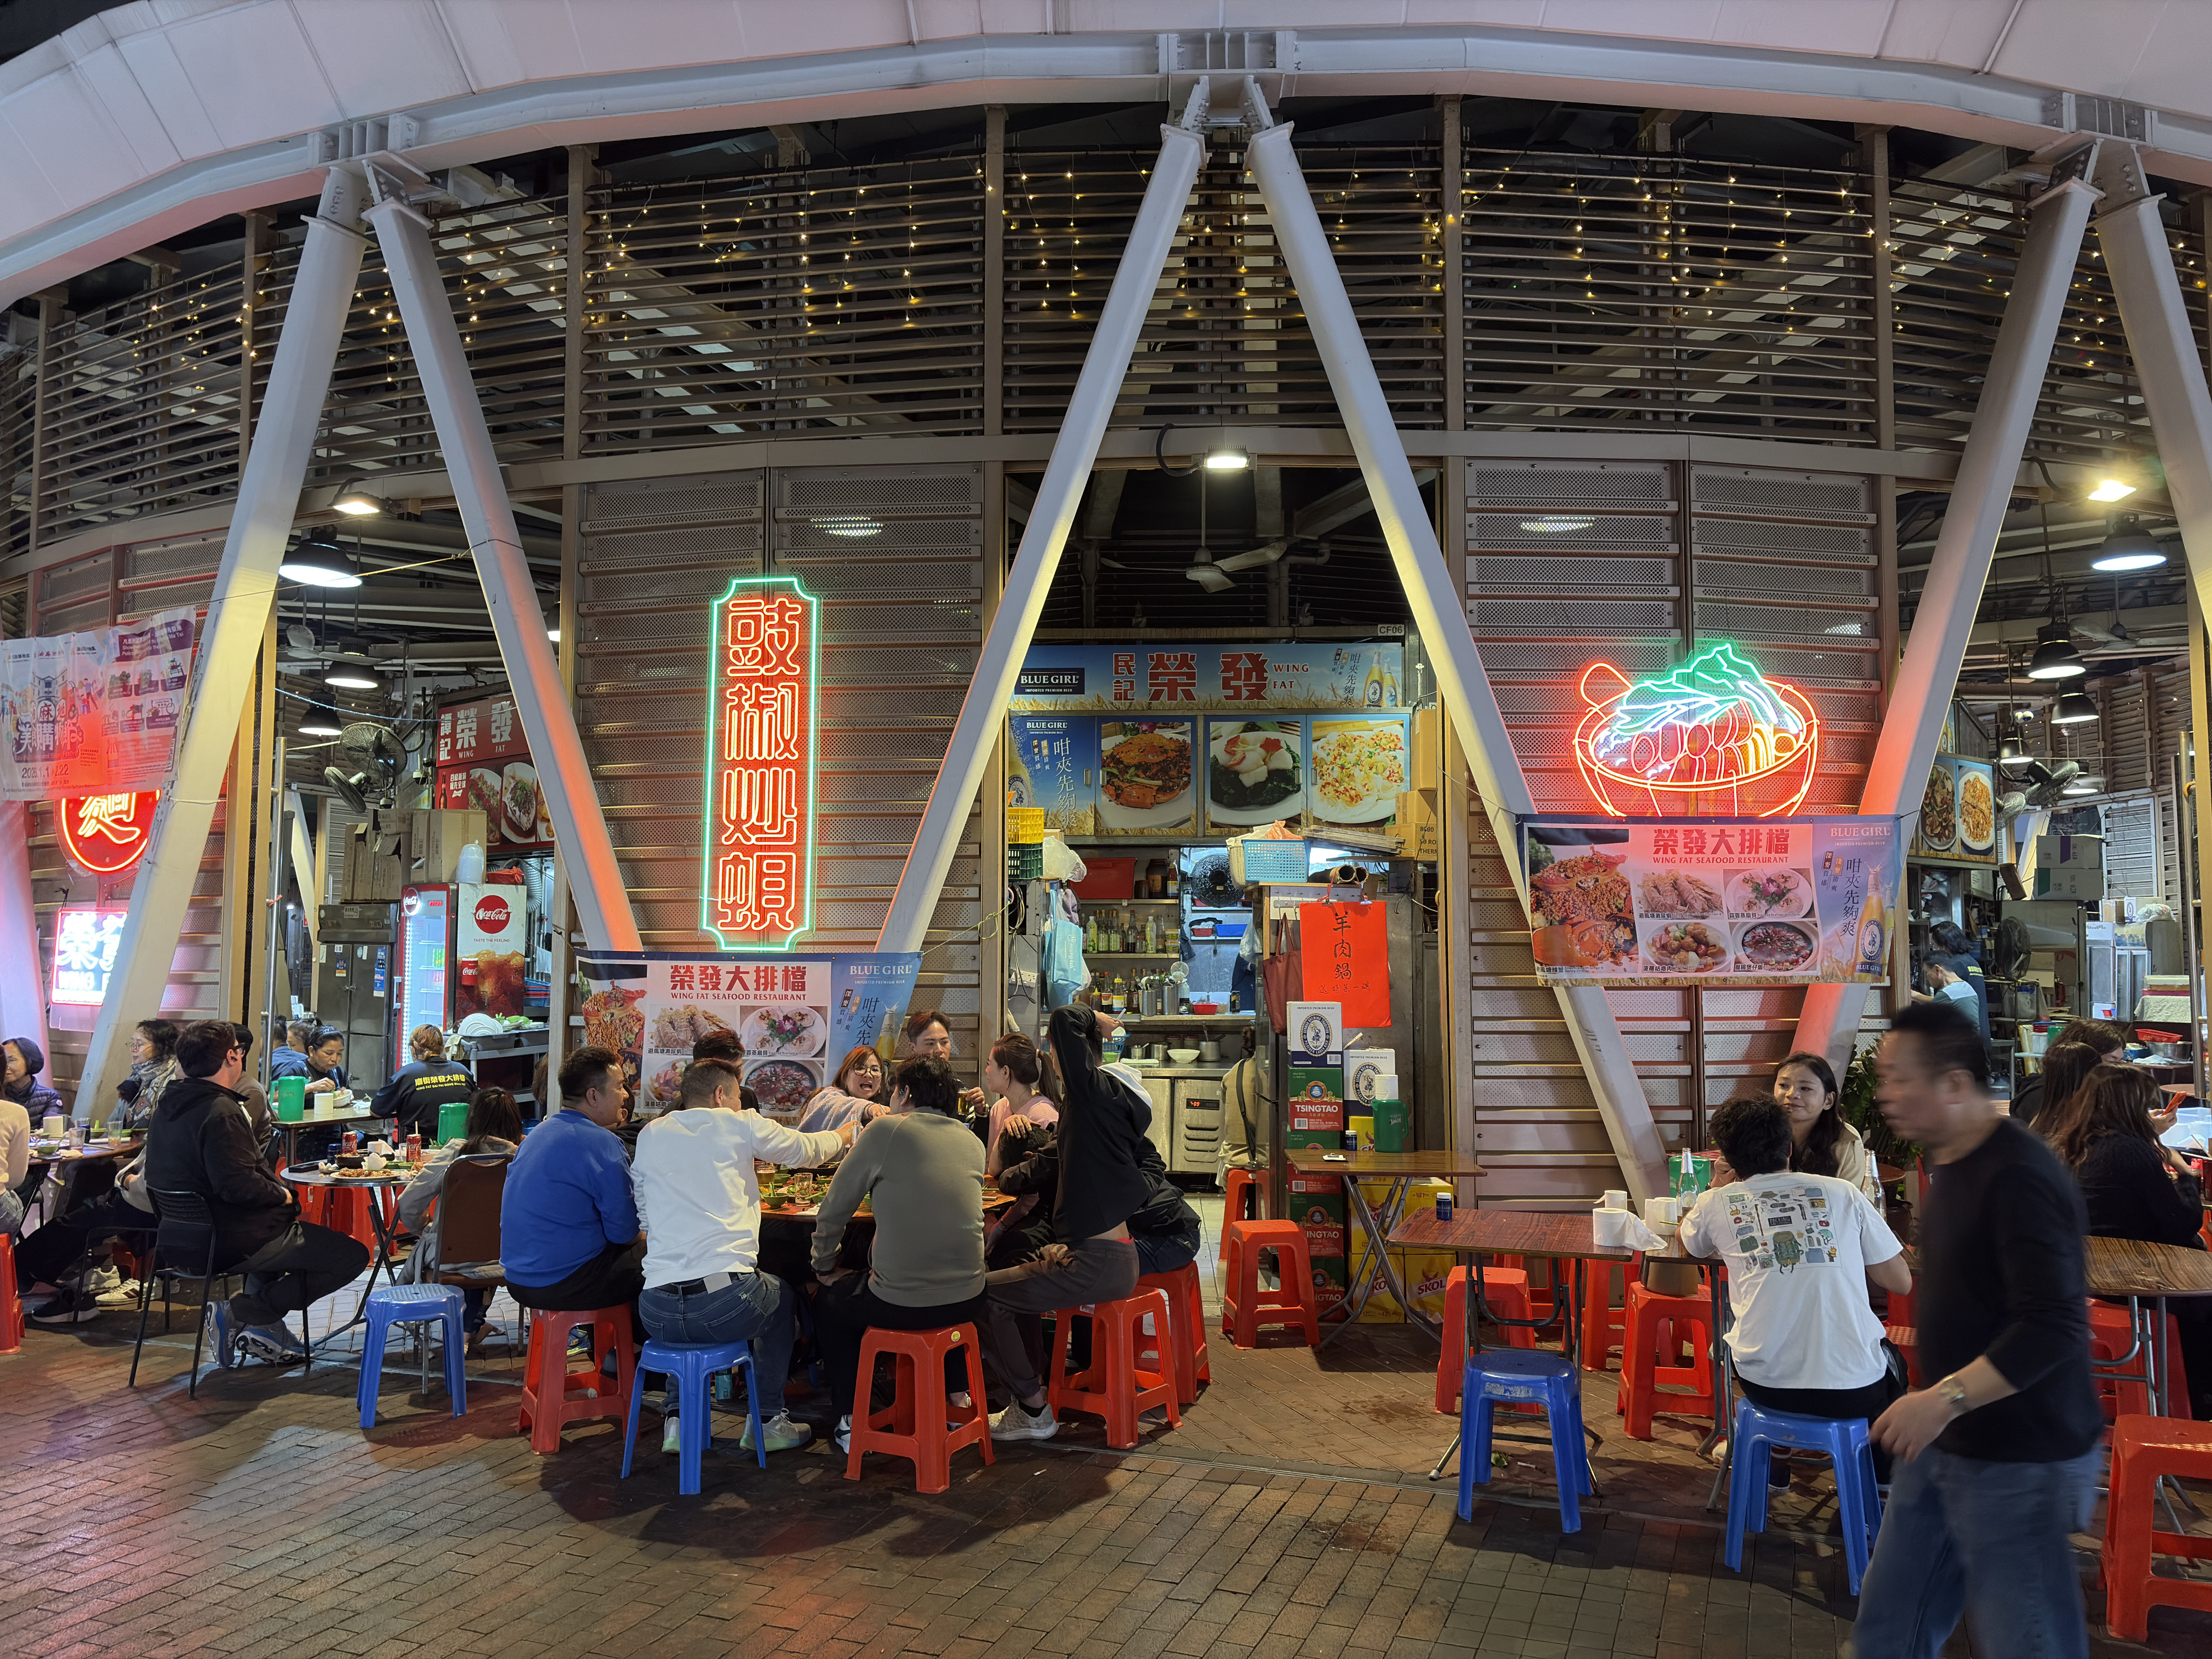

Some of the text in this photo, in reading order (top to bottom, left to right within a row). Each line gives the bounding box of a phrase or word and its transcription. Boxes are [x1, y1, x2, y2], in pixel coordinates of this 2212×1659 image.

[1020, 675, 1078, 684] BLUE GIRL
[1113, 653, 1136, 702] 民記
[1146, 651, 1270, 702] 榮發
[1273, 663, 1309, 672] WING
[1341, 653, 1361, 706] 咁夾先夠爽
[1273, 680, 1295, 689] FAT
[439, 713, 452, 761] 譚記
[456, 701, 513, 750] 榮發
[458, 750, 474, 759] WING
[1053, 737, 1078, 831] 咁夾先夠爽
[1653, 828, 1790, 855] 榮發大排檔
[1830, 827, 1890, 837] BLUE GIRL
[1840, 858, 1863, 937] 咁夾先夠爽
[476, 907, 507, 921] Coca-Cola
[1333, 911, 1352, 980] 羊肉鍋
[670, 964, 807, 992] 榮發大排檔
[849, 964, 912, 975] BLUE GIRL
[853, 997, 880, 1045] 咁夾先
[1295, 1104, 1338, 1113] TSINGTAO
[1417, 1279, 1446, 1295] SKOL
